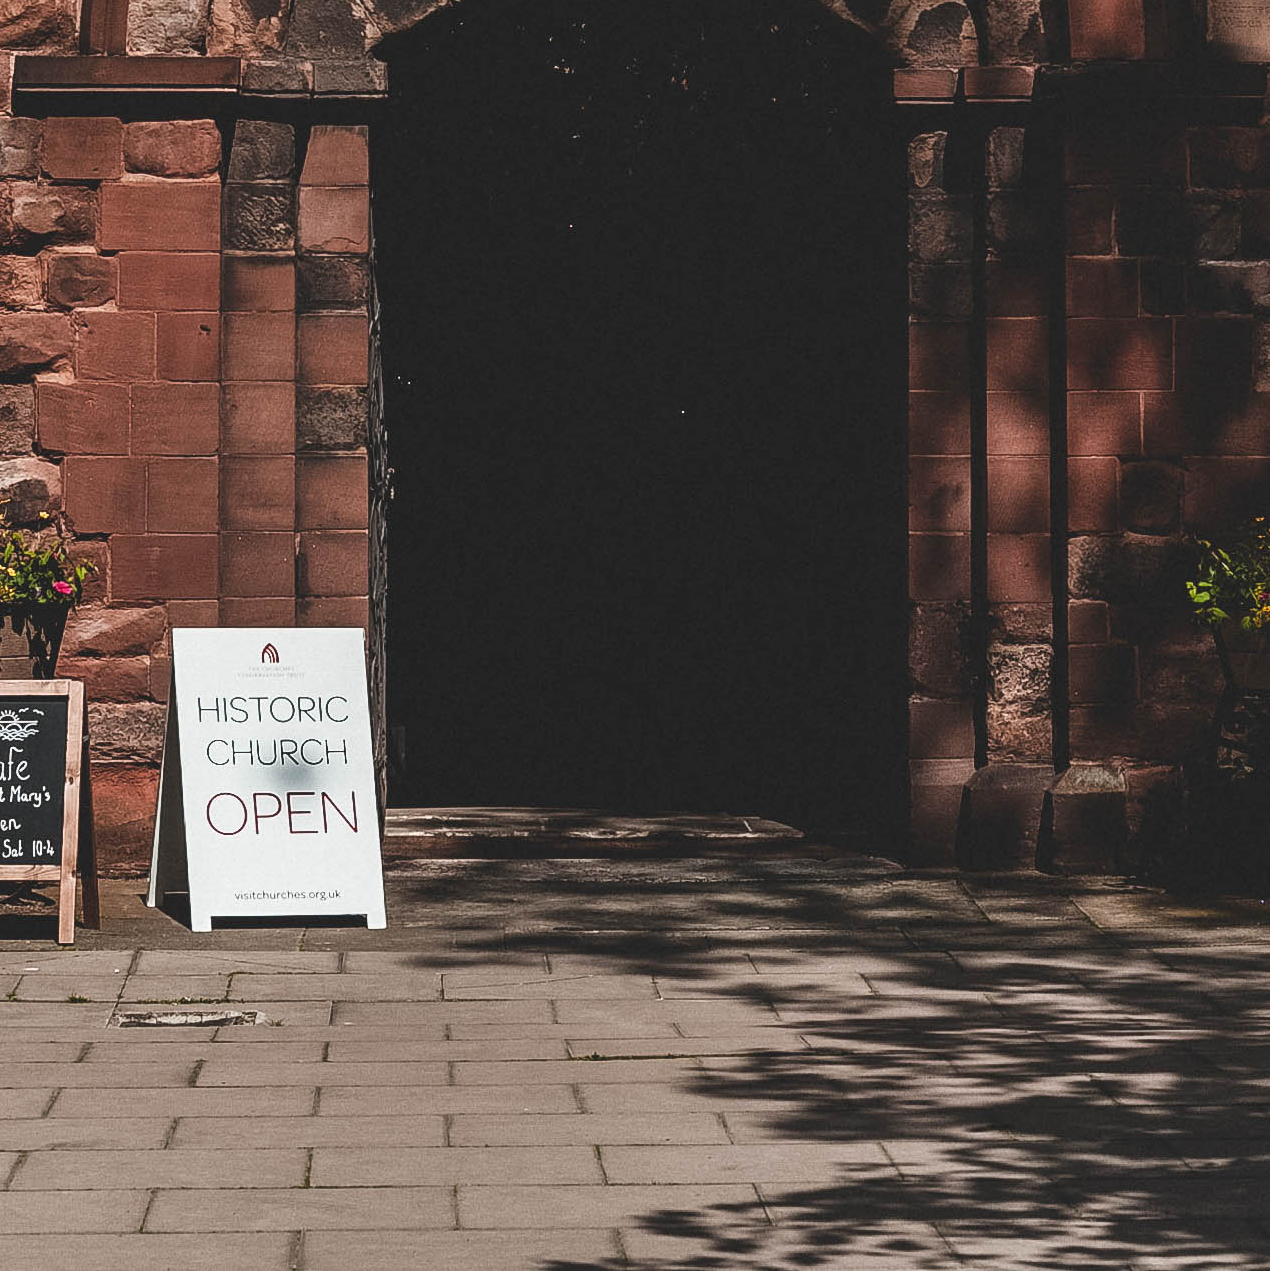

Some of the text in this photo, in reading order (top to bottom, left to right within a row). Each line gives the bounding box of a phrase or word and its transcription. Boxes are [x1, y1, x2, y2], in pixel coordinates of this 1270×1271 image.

[197, 696, 349, 723] HISTORIC
[206, 738, 348, 766] CHURCH
[9, 785, 51, 808] Mary's
[206, 791, 358, 836] OPEN
[234, 890, 341, 901] visitchurches.org.uk
